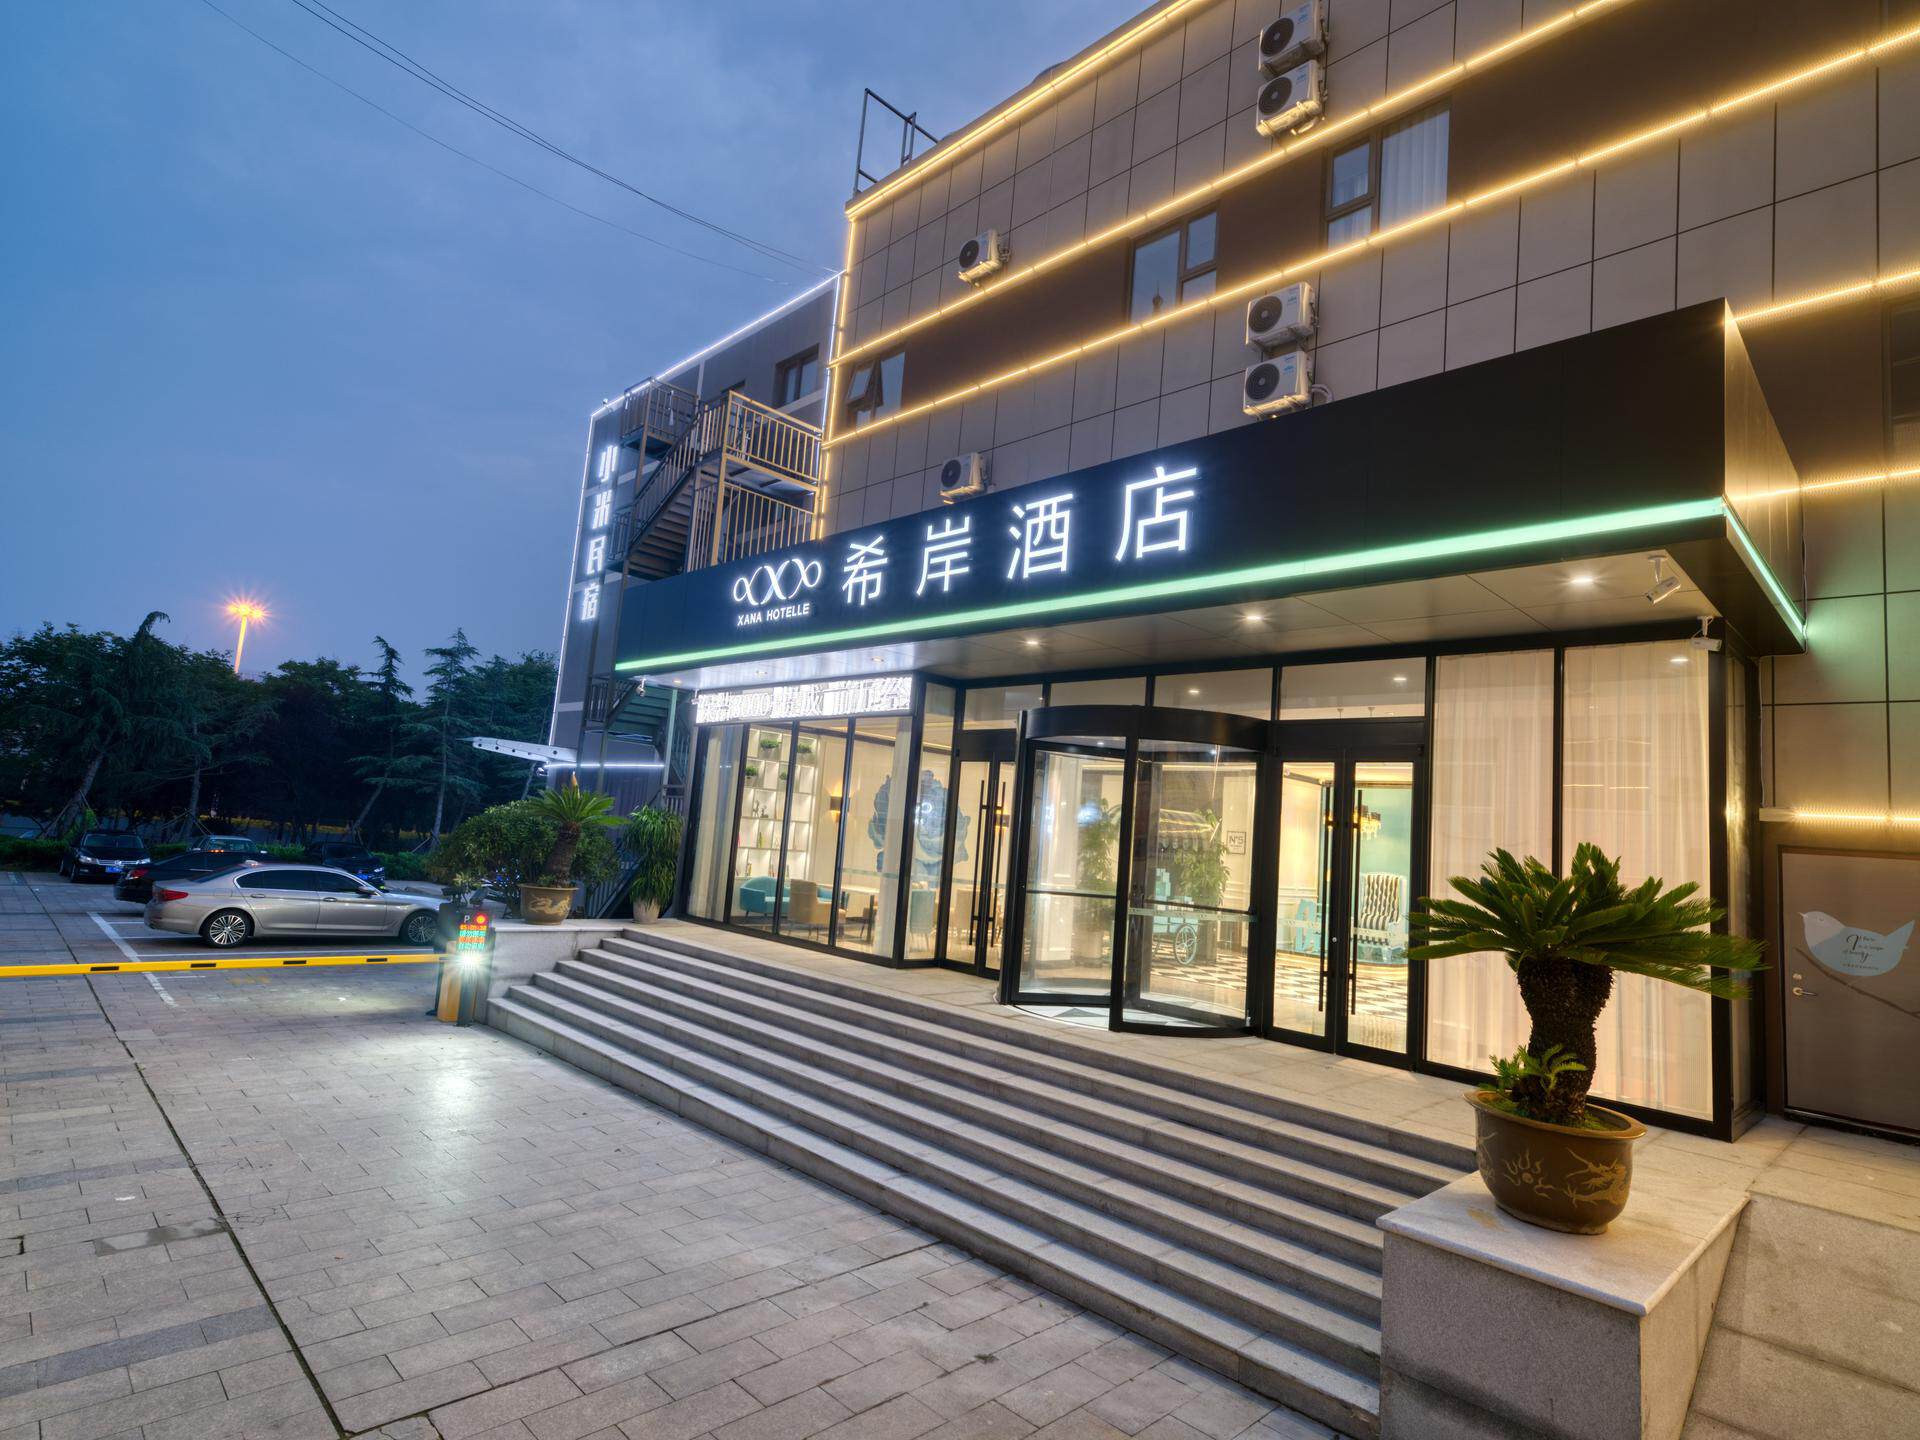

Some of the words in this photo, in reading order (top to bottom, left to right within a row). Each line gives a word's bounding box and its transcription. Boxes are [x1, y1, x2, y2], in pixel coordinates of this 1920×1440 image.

[841, 465, 1198, 607] 希岸酒店
[737, 611, 762, 627] XANA
[766, 603, 810, 621] HOTELLE
